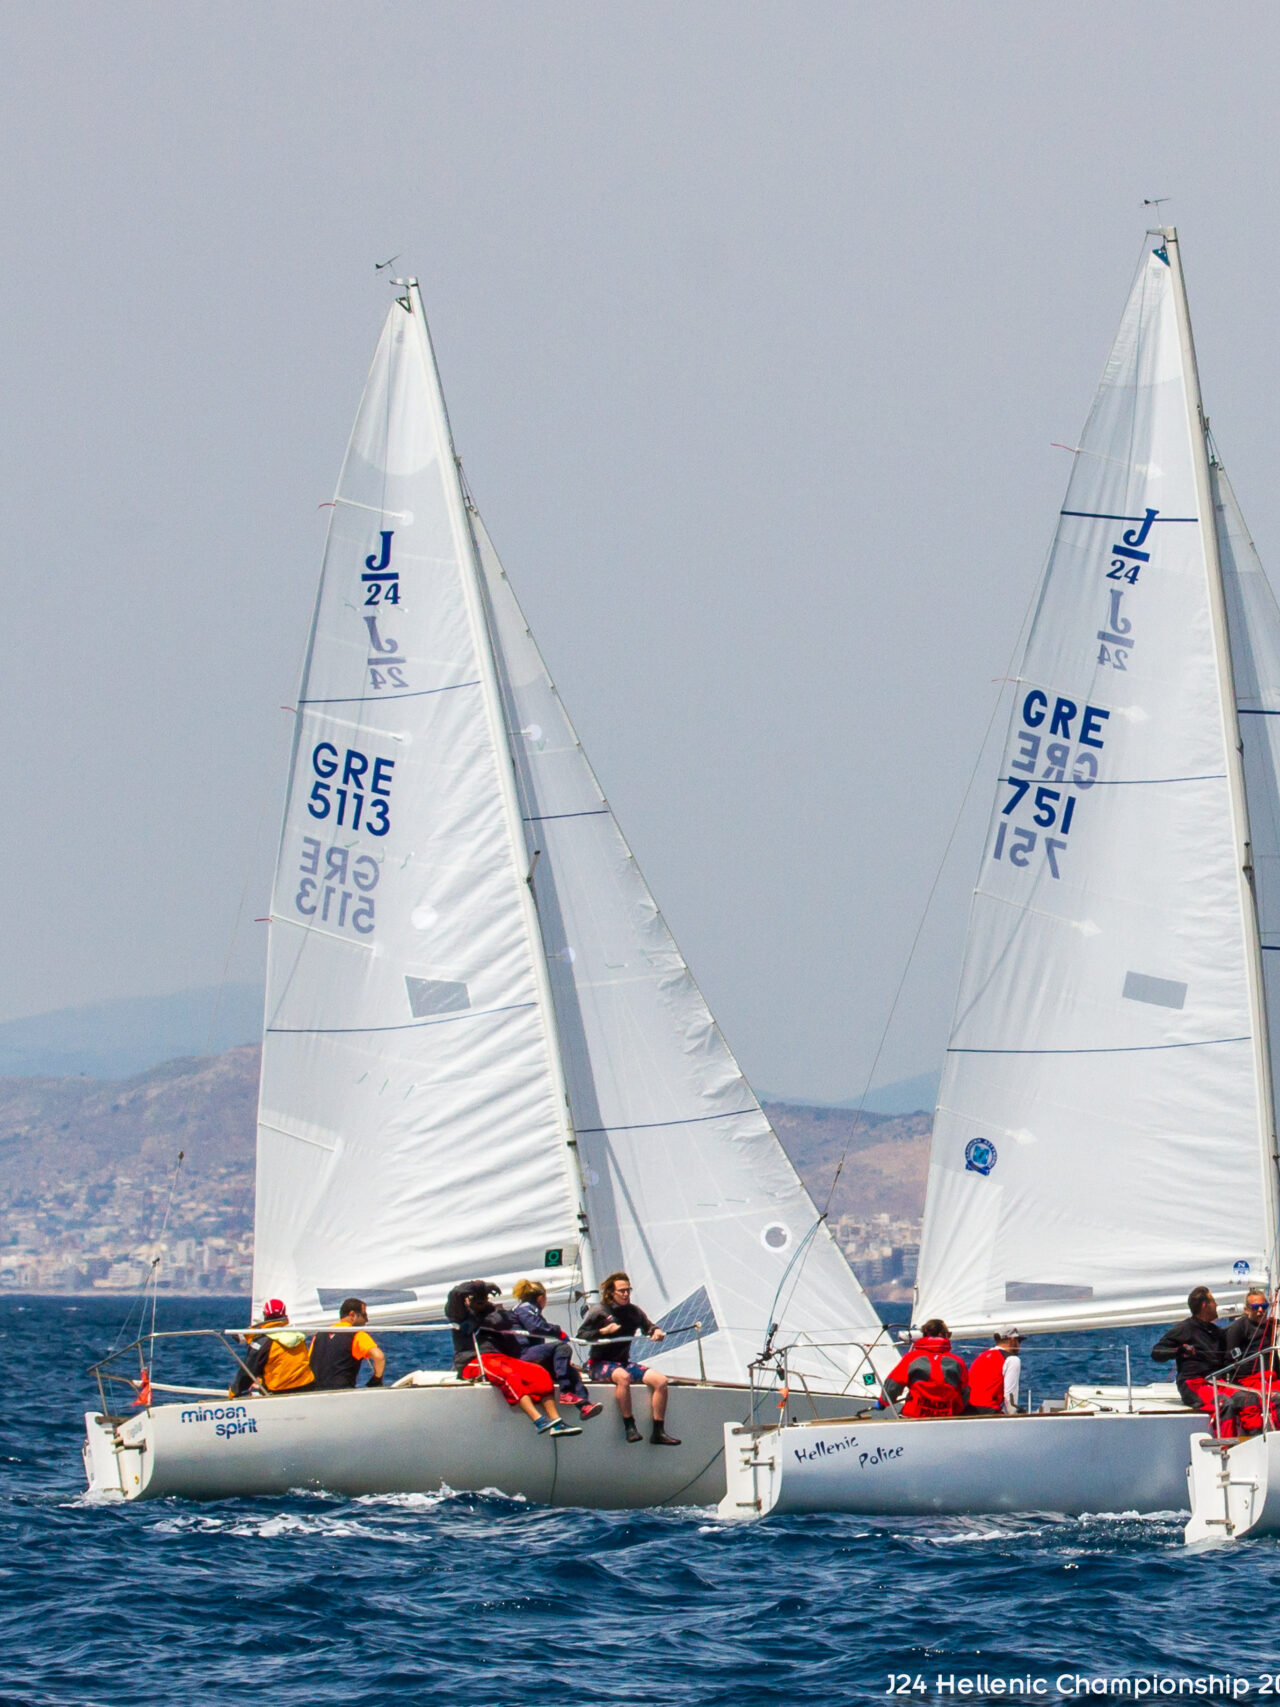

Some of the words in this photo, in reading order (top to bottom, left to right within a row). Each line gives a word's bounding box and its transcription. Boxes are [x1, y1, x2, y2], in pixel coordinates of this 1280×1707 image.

[1123, 508, 1159, 547] J
[365, 531, 395, 572] J
[1106, 559, 1141, 585] 24
[364, 582, 401, 606] 24
[1022, 689, 1110, 749] GRE
[312, 742, 395, 797] GRE
[307, 780, 391, 836] 5113
[1001, 776, 1077, 835] 751
[181, 1406, 247, 1423] minoan
[216, 1418, 258, 1439] spirit
[794, 1437, 859, 1463] Hellenic
[859, 1446, 904, 1468] Police
